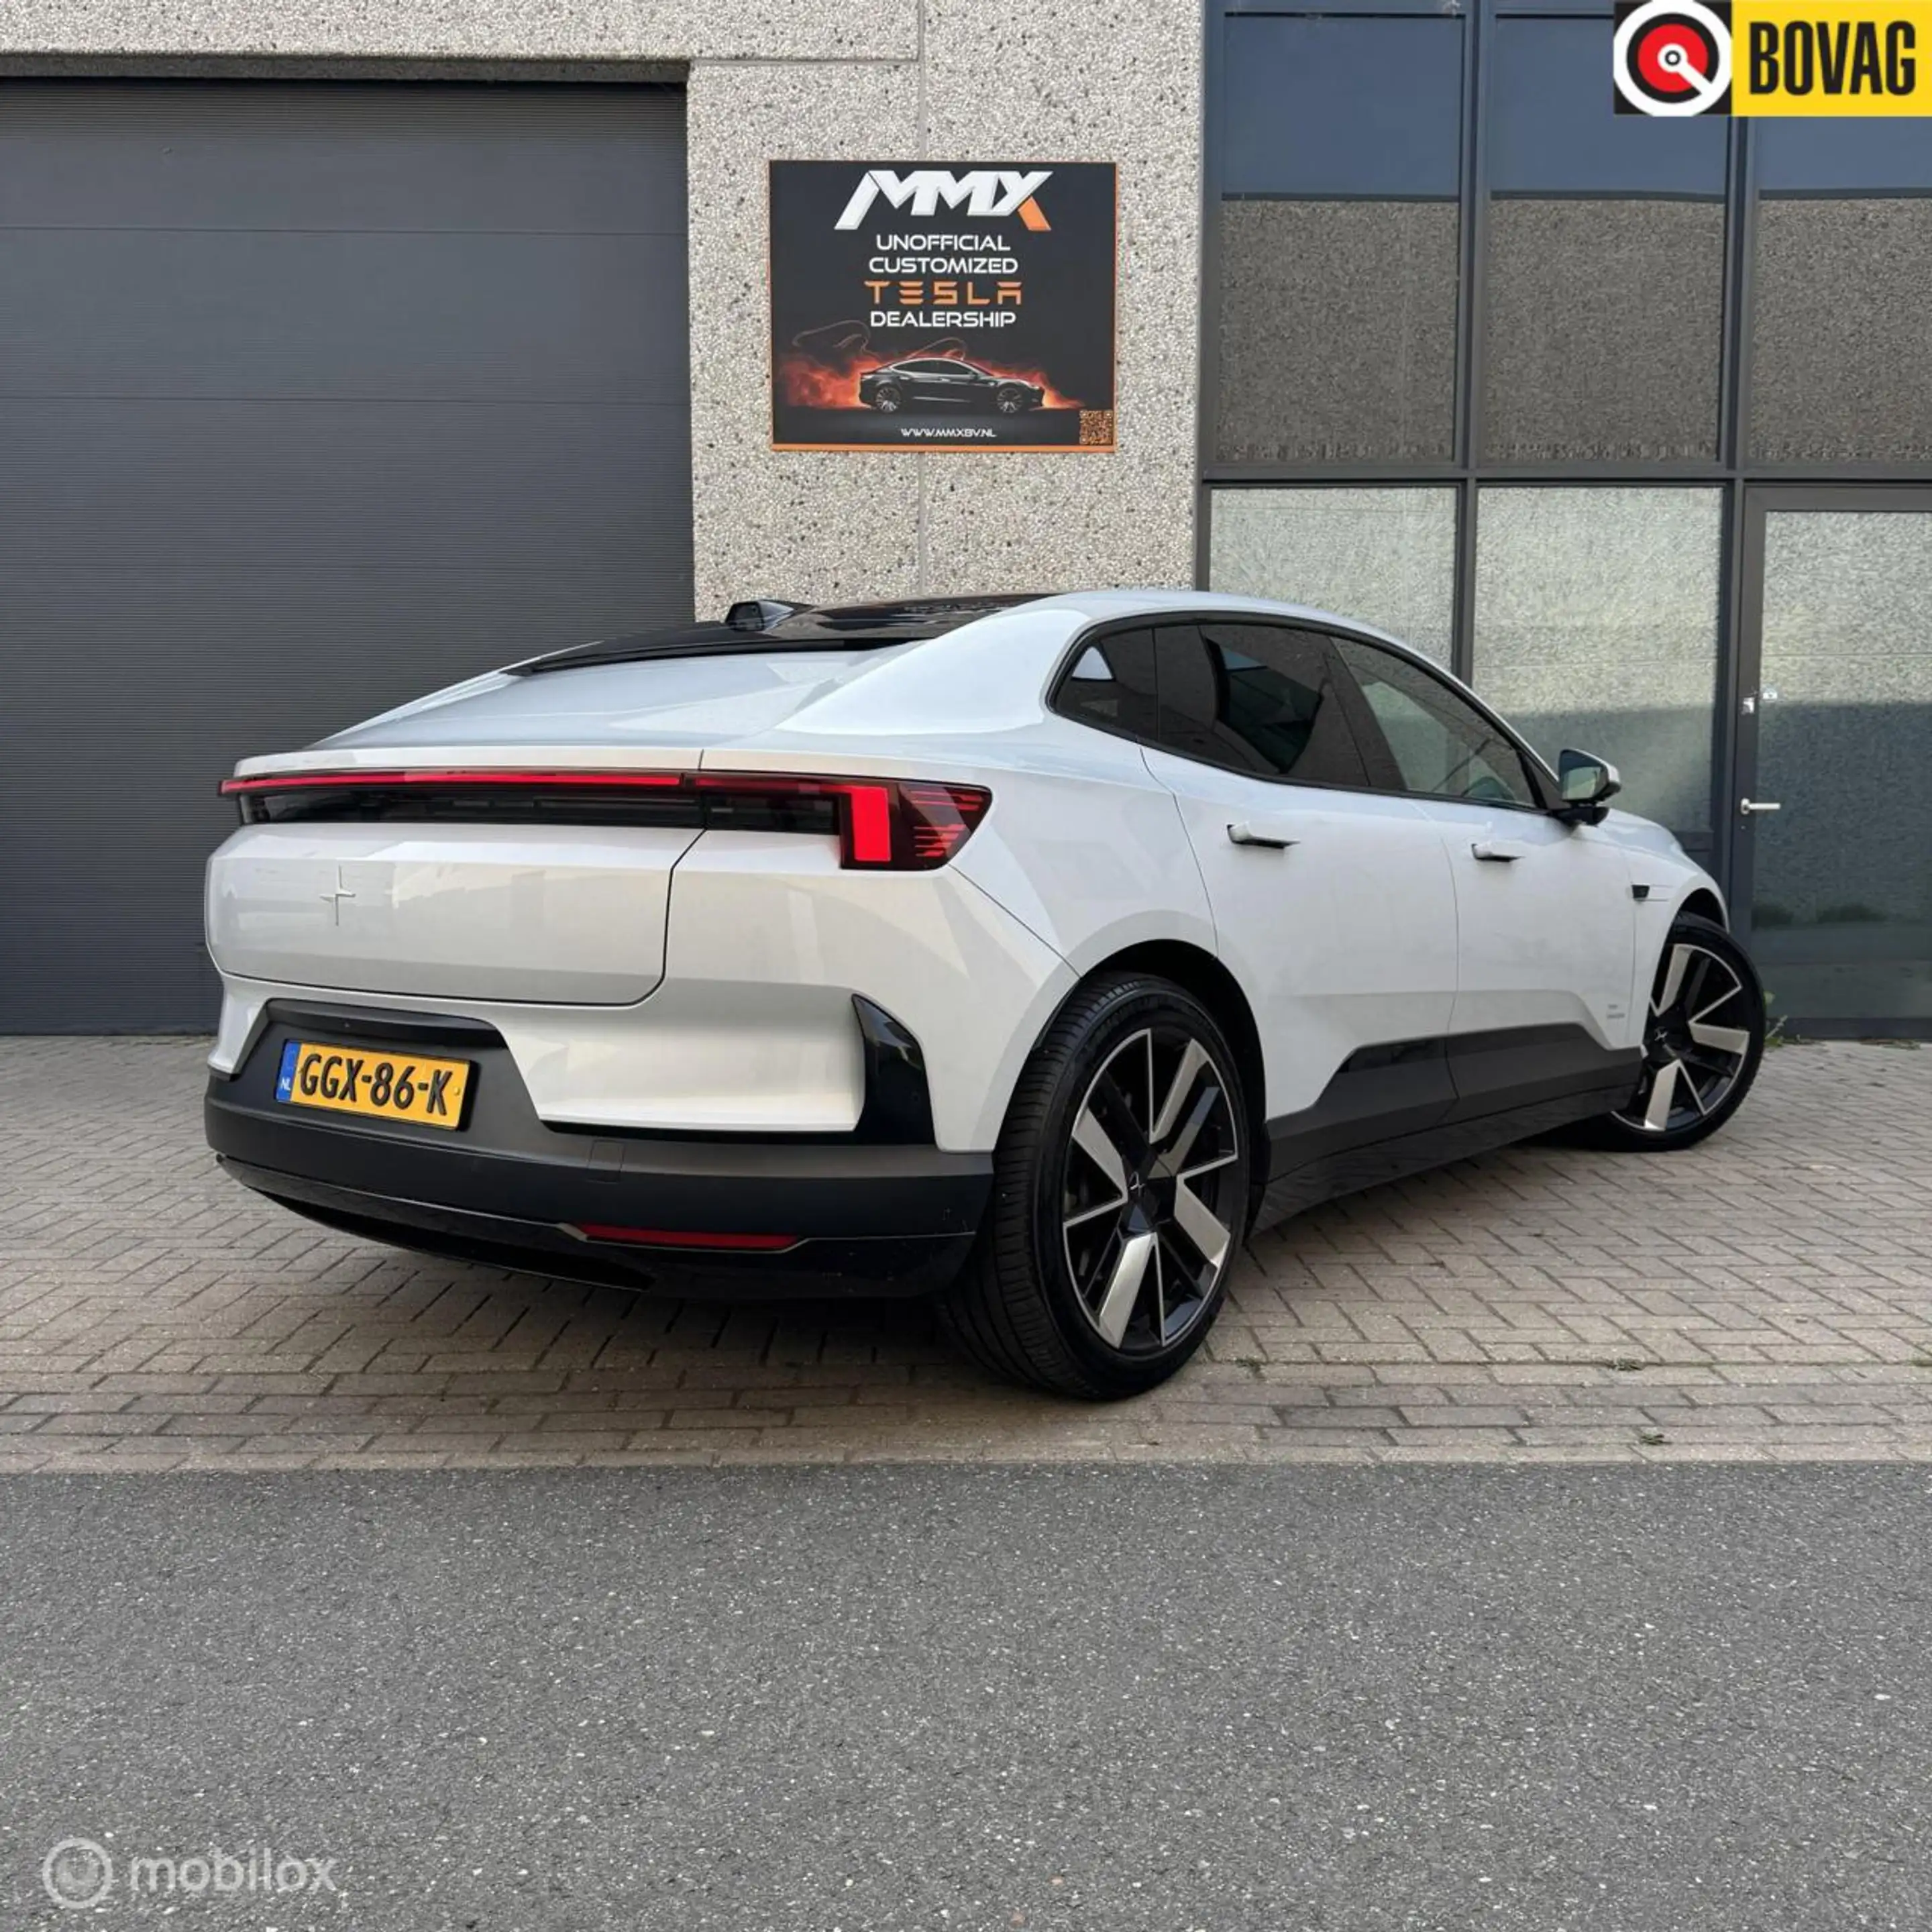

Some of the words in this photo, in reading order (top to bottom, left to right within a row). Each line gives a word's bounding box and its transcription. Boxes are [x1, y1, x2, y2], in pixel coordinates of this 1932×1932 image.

[834, 170, 1054, 231] MMX
[876, 234, 1011, 251] UNOFFICIAL
[869, 257, 1018, 274] CUSTOMIZED
[863, 280, 1022, 305] TESLA
[870, 311, 1016, 328] DEALERSHIP
[900, 427, 997, 437] WWW.MMXBV.NL
[280, 1076, 291, 1091] NL
[300, 1053, 453, 1116] GGX-86-K
